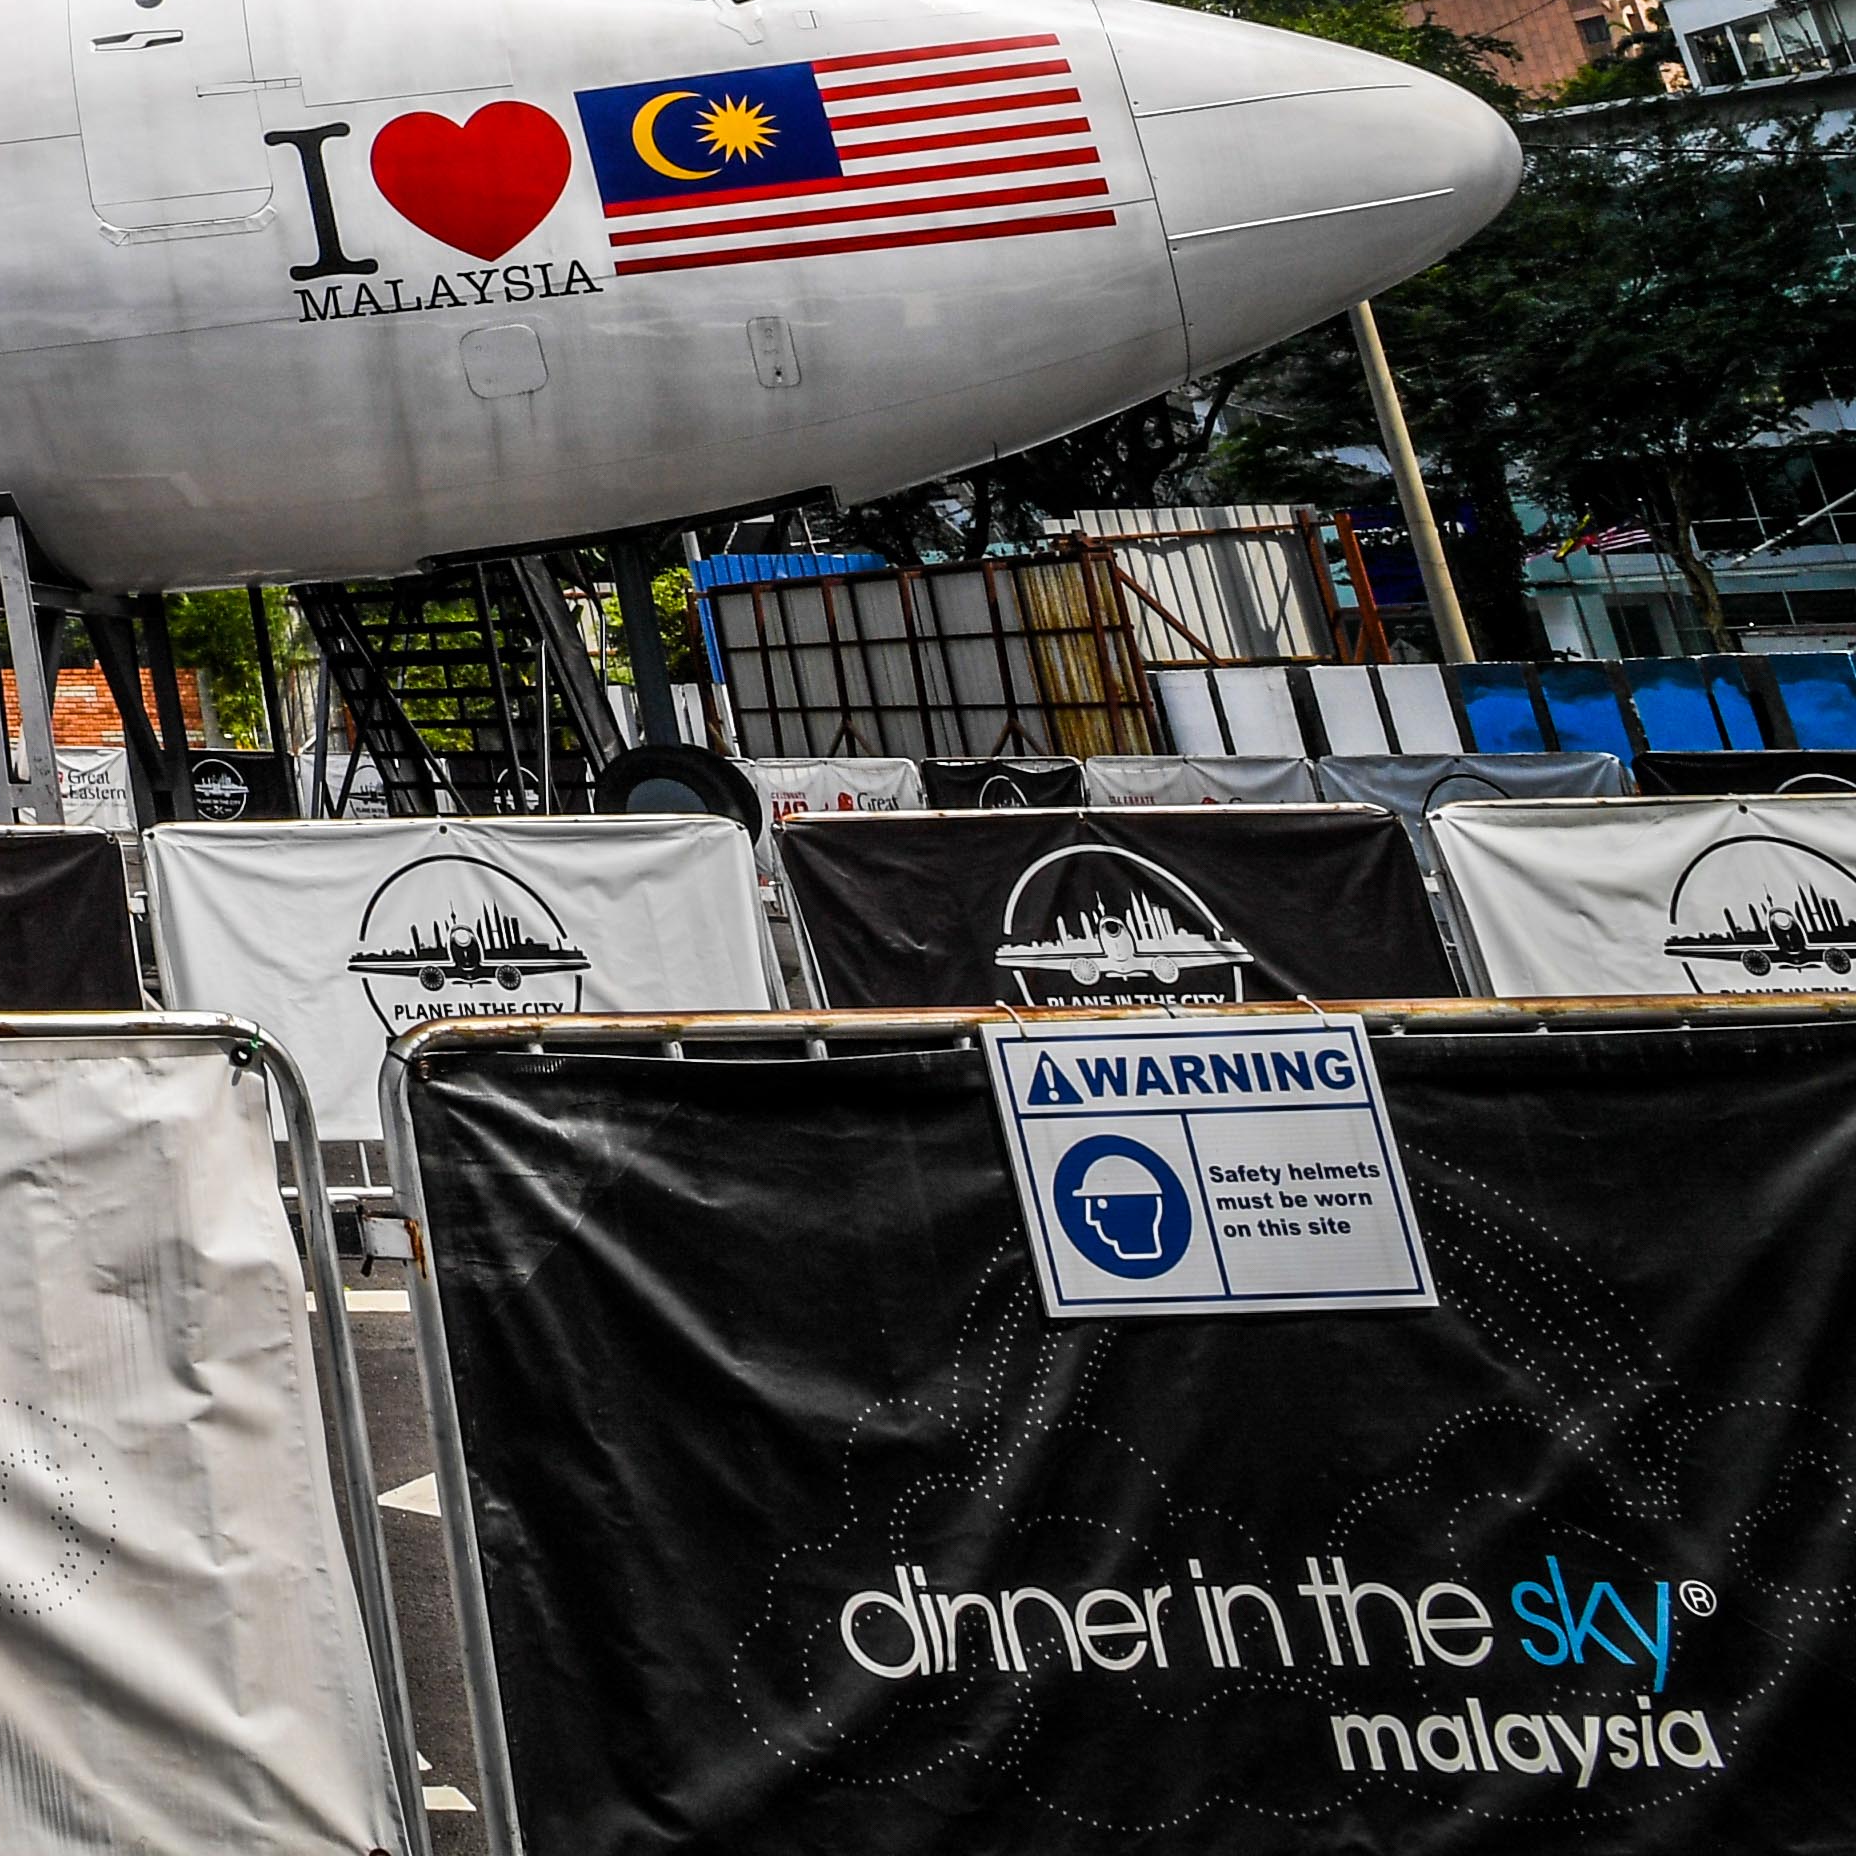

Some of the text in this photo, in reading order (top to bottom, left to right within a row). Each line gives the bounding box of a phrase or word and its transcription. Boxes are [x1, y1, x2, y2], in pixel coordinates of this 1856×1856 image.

[263, 122, 379, 281] I
[294, 259, 603, 324] MALAYSIA
[67, 770, 110, 785] Great
[68, 785, 127, 801] Eastern
[395, 1003, 452, 1020] PLANE
[459, 1003, 475, 1015] IN
[1076, 1048, 1356, 1098] WARNING
[1209, 1161, 1381, 1186] Safety helmets
[1217, 1191, 1372, 1211] must be worn
[1223, 1217, 1351, 1238] on this site
[839, 1563, 1172, 1679] dinner
[1187, 1557, 1296, 1669] in
[1298, 1555, 1494, 1670] the
[1329, 1696, 1725, 1788] malaysia
